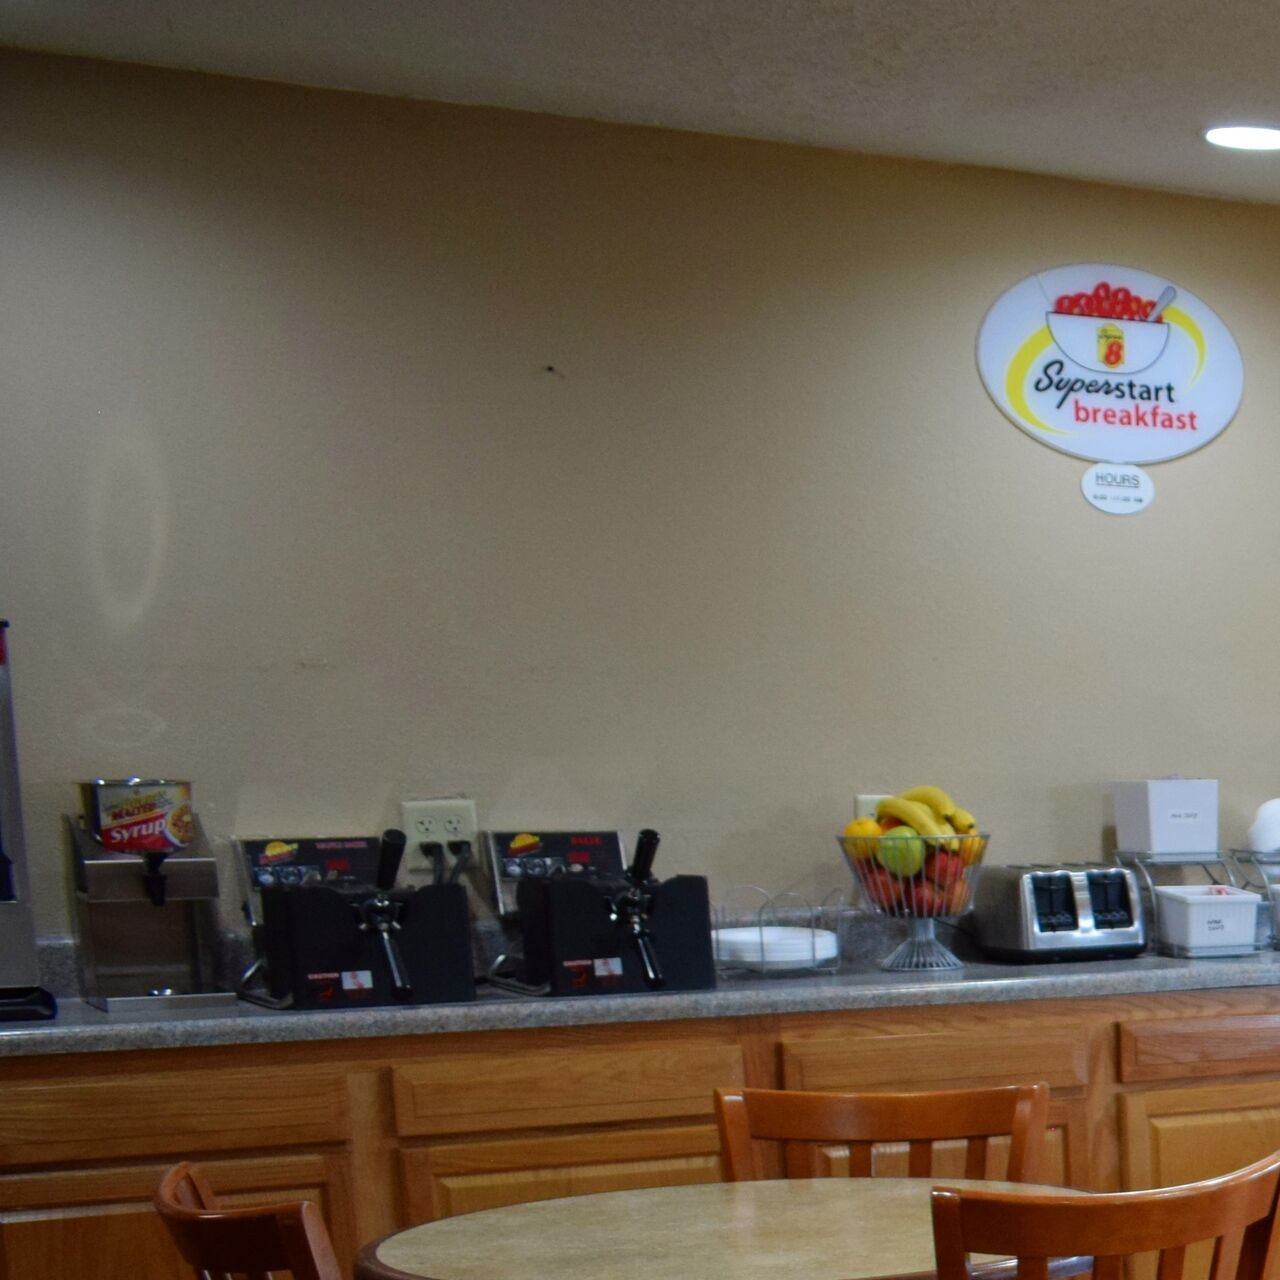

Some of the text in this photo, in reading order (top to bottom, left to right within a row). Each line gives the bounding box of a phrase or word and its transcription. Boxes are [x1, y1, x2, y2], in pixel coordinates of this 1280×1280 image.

[1105, 340, 1122, 366] 8
[1034, 359, 1176, 410] Superstart
[1074, 398, 1198, 431] breakfast
[1095, 472, 1140, 486] HOURS
[110, 818, 166, 843] Syrup
